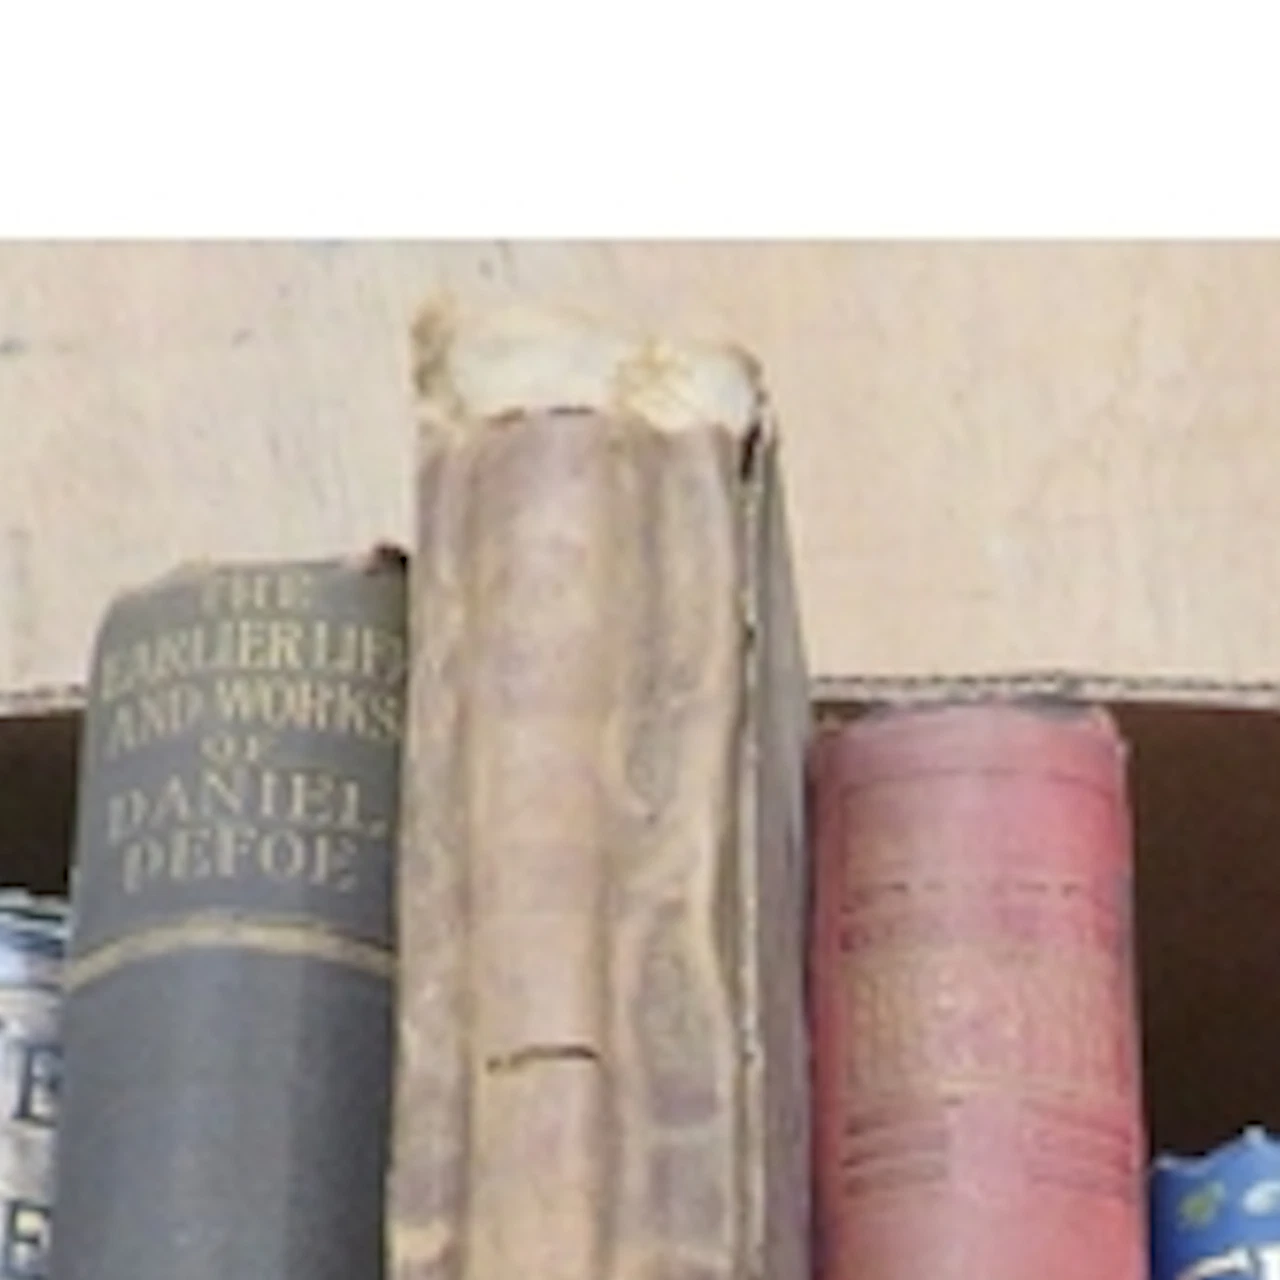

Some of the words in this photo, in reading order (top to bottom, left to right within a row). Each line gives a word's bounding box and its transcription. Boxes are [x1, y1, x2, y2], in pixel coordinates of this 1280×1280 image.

[107, 684, 202, 758] AND
[216, 675, 399, 738] WORKS
[107, 768, 388, 847] DANIEL
[124, 824, 359, 894] DEFOE
